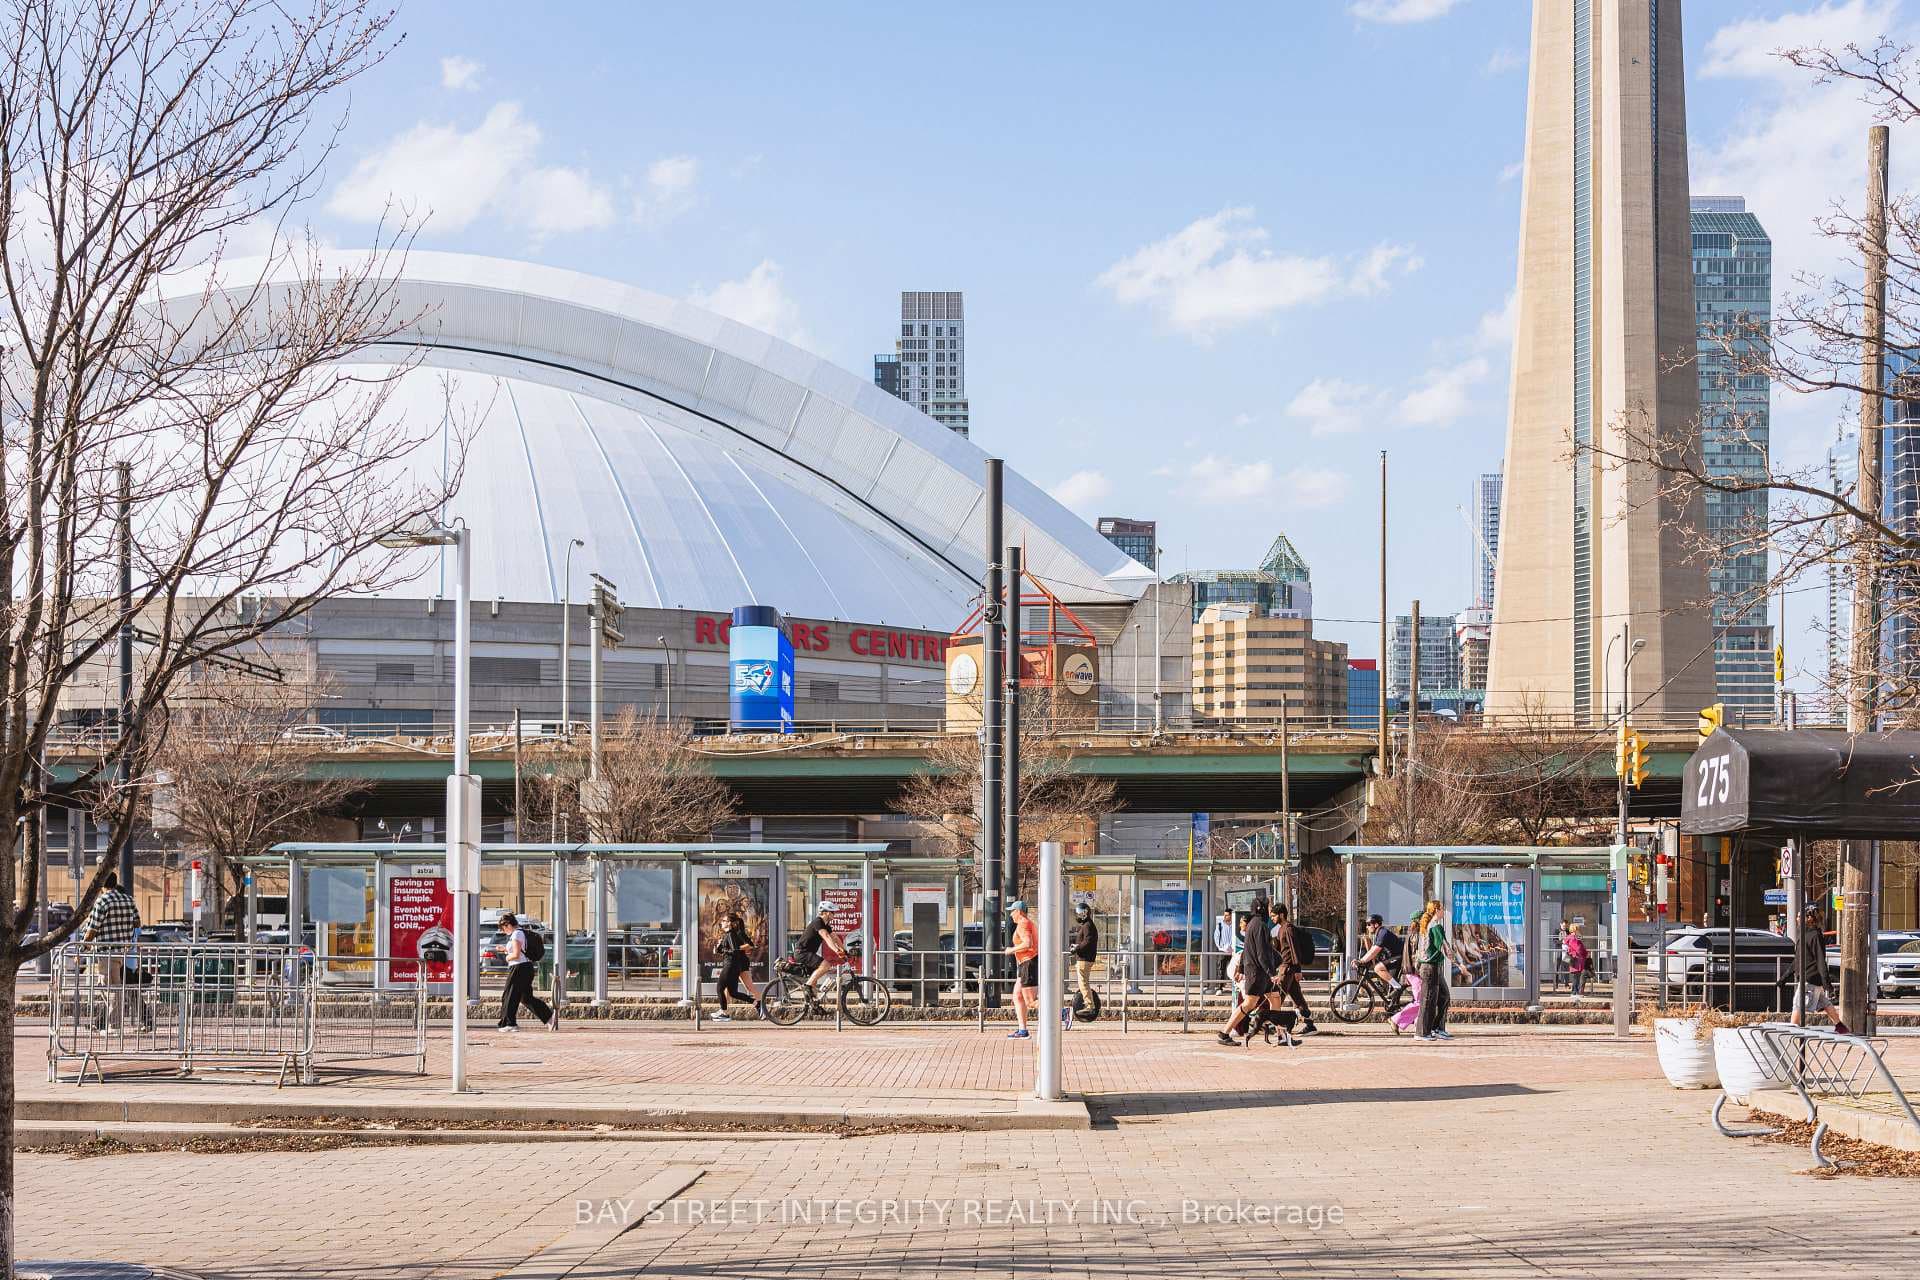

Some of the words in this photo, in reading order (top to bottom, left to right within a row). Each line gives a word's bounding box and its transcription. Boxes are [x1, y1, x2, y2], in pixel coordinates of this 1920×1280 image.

[694, 617, 831, 652] RRS
[1065, 671, 1094, 681] enwave
[1697, 754, 1730, 808] 275
[394, 879, 422, 887] Saving
[394, 886, 434, 894] insurance
[394, 894, 402, 902] is
[403, 894, 433, 904] simple.
